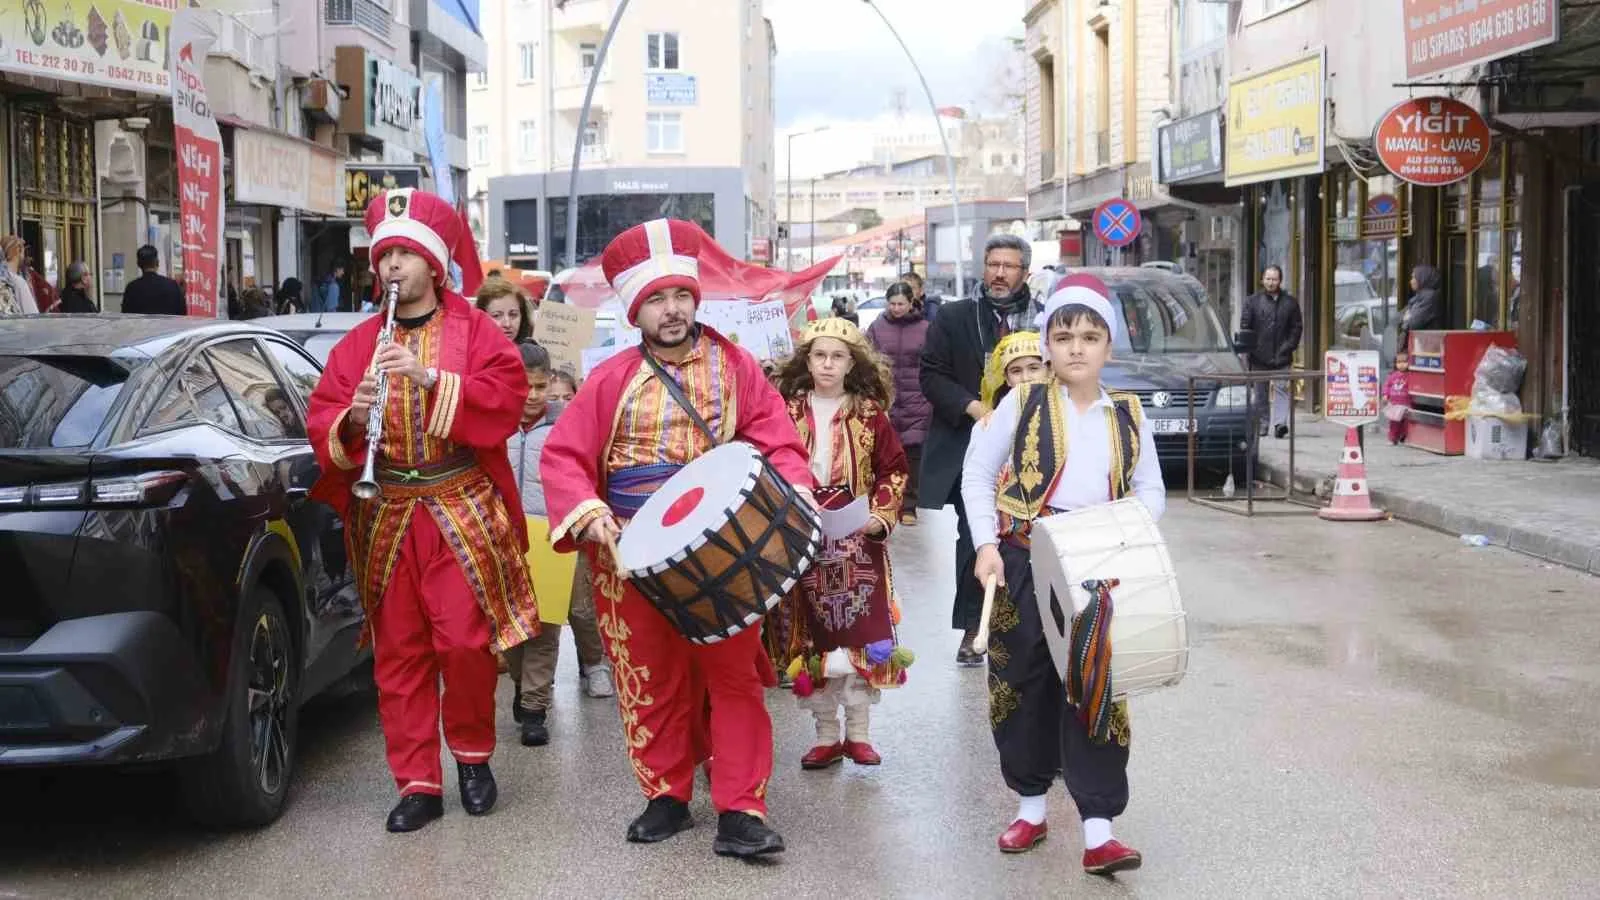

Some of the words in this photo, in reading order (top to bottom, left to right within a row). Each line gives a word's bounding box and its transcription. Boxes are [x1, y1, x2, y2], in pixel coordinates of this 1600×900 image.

[1411, 38, 1428, 64] ALO
[1469, 15, 1493, 47] 0544
[1495, 8, 1514, 38] 636
[1516, 3, 1530, 32] 93
[16, 49, 39, 65] TEL:
[41, 54, 60, 69] 212
[63, 57, 78, 72] 30
[108, 65, 135, 81] 0542
[136, 70, 153, 83] 715
[1385, 136, 1429, 152] MAYALI
[1440, 136, 1481, 157] LAVAŞ
